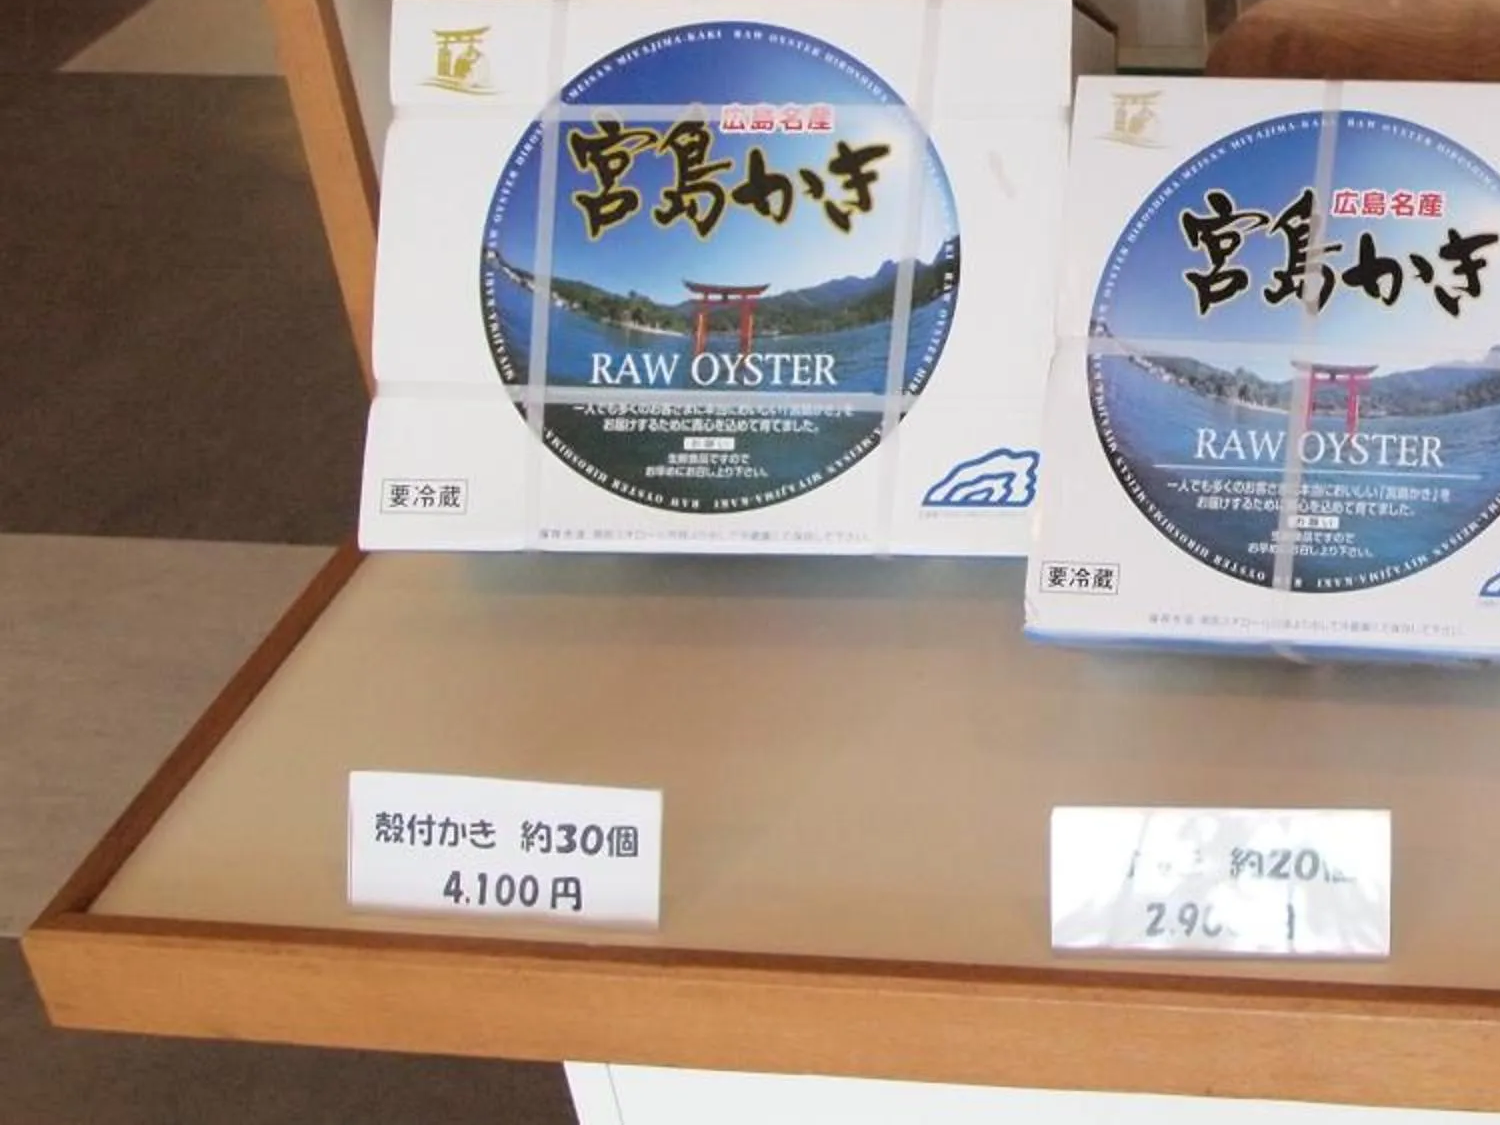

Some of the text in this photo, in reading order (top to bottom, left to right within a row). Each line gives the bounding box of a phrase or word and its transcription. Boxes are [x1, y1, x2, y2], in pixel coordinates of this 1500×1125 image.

[721, 104, 833, 132] 広島名産
[567, 105, 892, 239] 宮島かき
[1333, 190, 1445, 218] 広島名産
[1182, 187, 1500, 315] 宮島かき
[590, 352, 837, 386] RAW OYSTER
[1194, 427, 1444, 468] RAW OYSTER
[389, 484, 461, 508] 要冷蔵
[1047, 565, 1114, 590] 要冷蔵
[375, 812, 640, 858] 殻付かき 約30個
[1230, 846, 1358, 882] 約20
